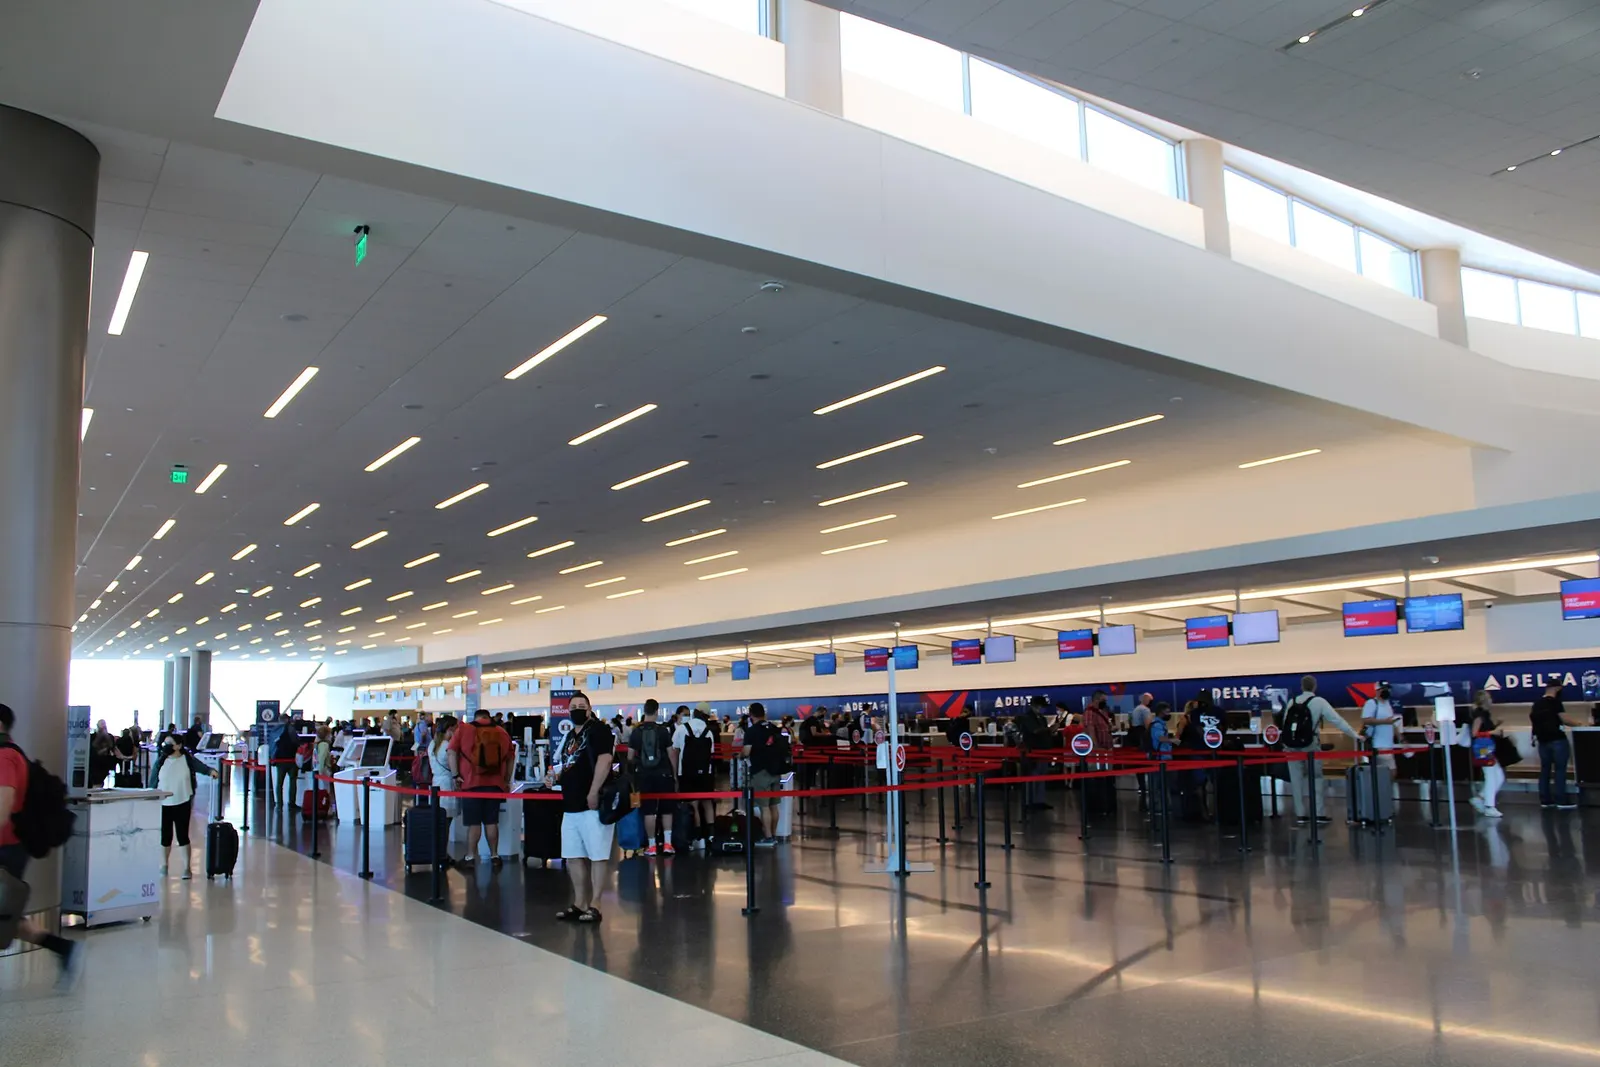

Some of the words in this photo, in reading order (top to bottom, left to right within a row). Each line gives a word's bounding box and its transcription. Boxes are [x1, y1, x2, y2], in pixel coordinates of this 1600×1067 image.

[1212, 686, 1260, 699] DELTA
[852, 702, 879, 711] DEA
[1005, 696, 1033, 706] DELT
[141, 883, 156, 898] SLC
